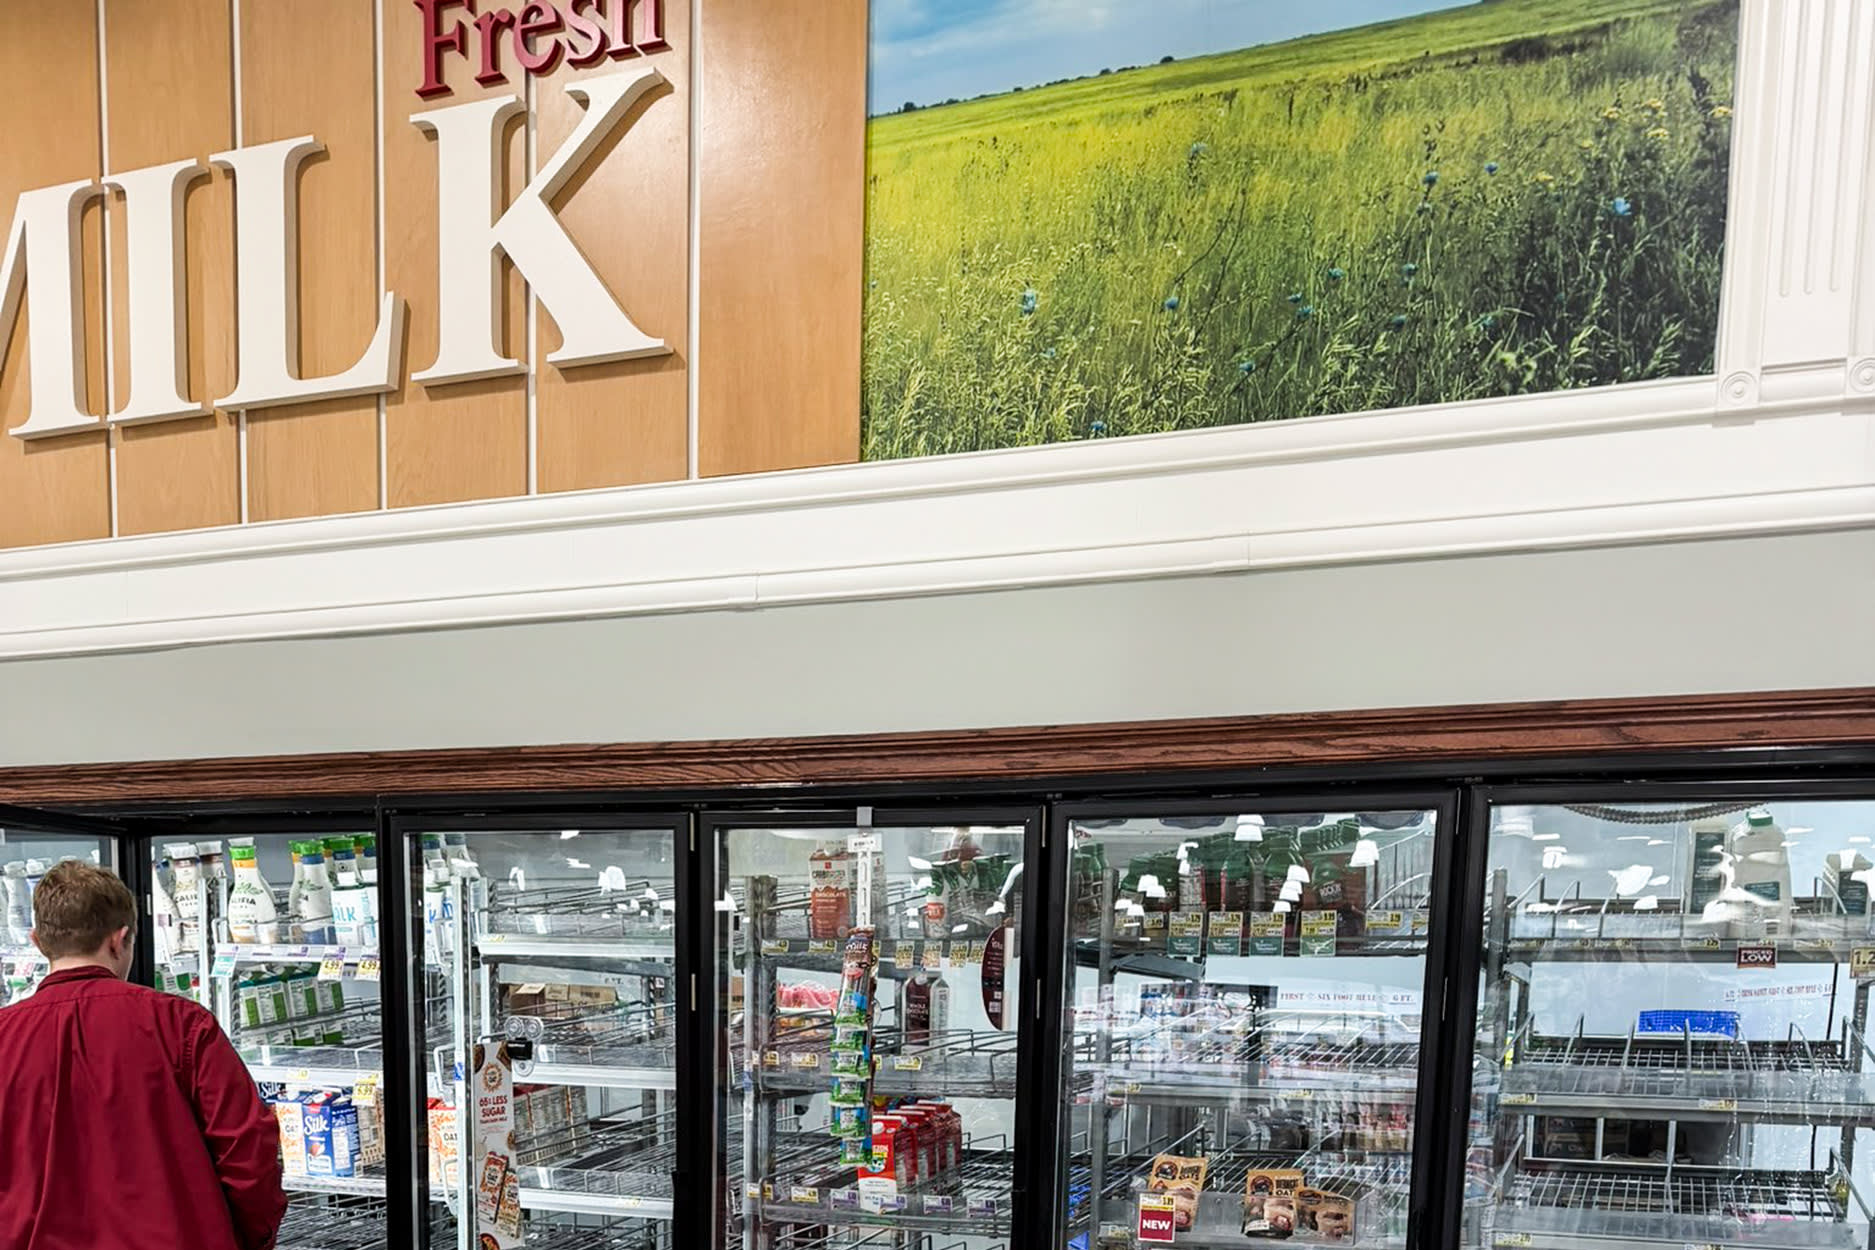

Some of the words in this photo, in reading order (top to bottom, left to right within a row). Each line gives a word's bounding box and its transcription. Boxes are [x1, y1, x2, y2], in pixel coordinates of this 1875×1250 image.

[414, 0, 670, 99] Fresh
[1741, 953, 1773, 963] LOW
[492, 1095, 508, 1105] LESS
[481, 1106, 506, 1117] SUGAR
[303, 1115, 330, 1136] Silk
[1142, 1217, 1171, 1231] NEW
